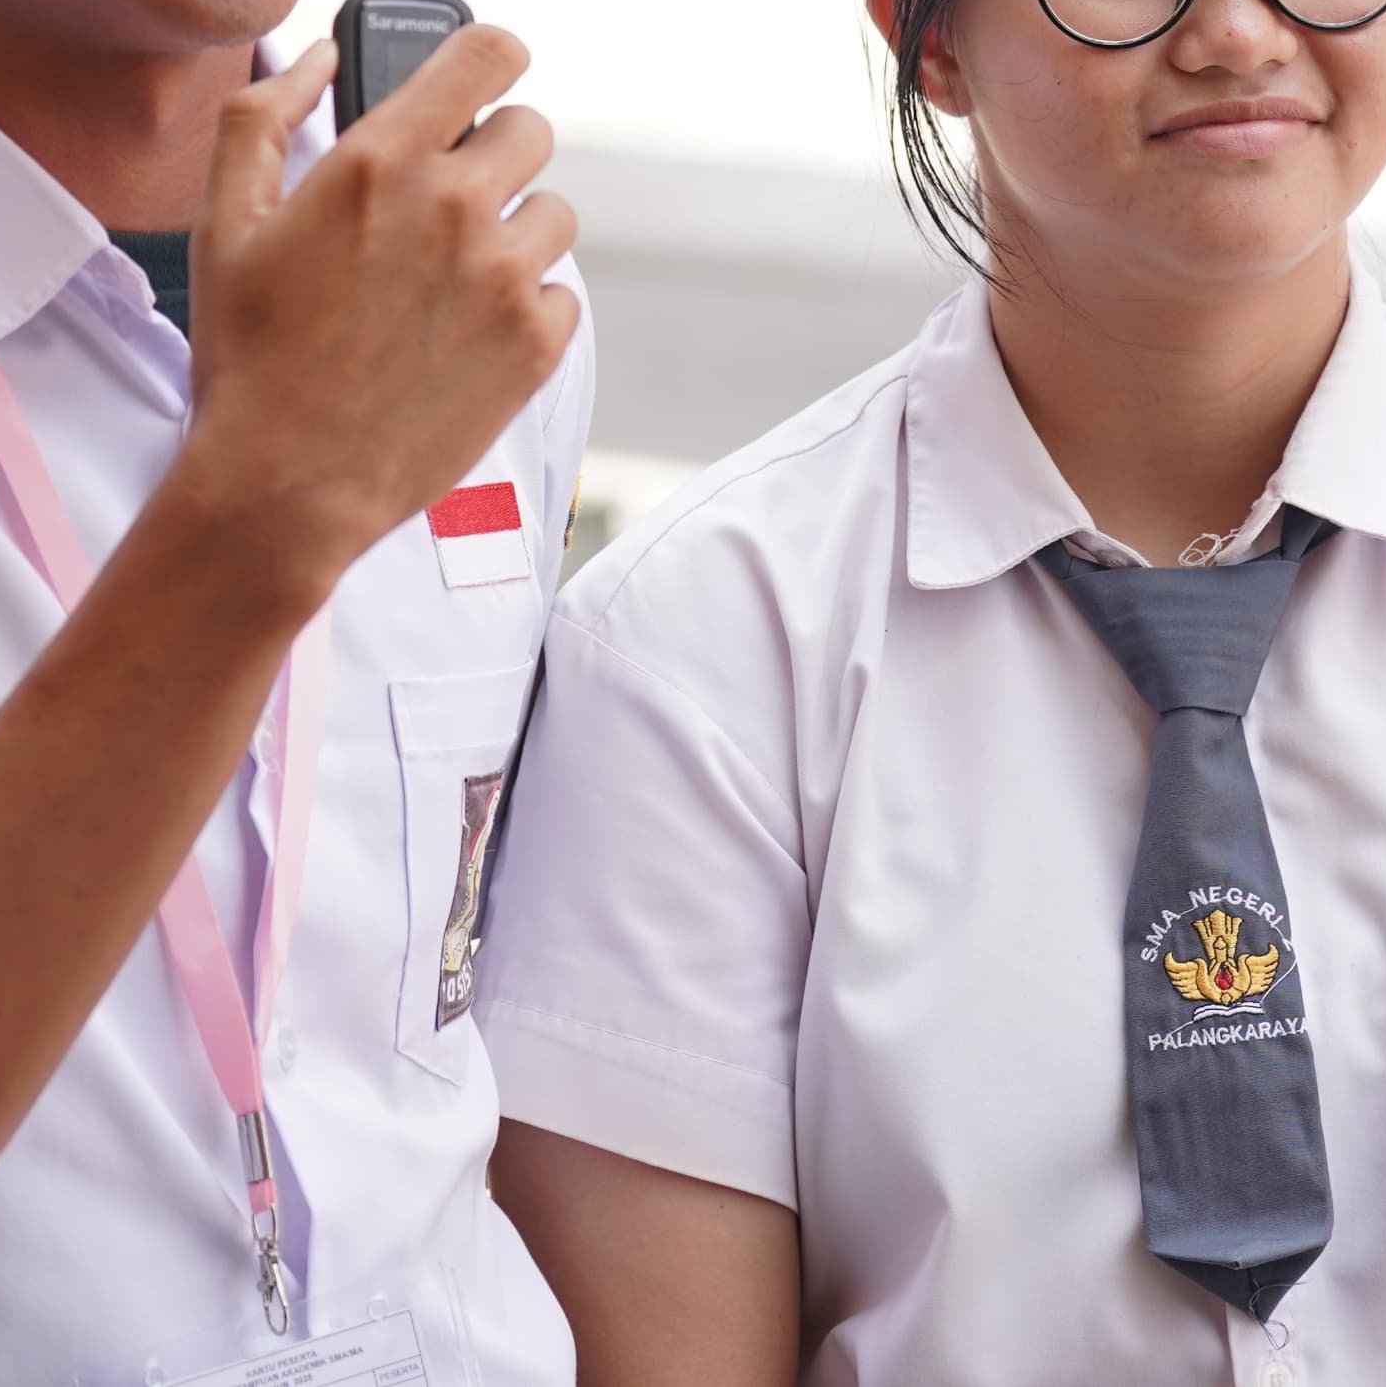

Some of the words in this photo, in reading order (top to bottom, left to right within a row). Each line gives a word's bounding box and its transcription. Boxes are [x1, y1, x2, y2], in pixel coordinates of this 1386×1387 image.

[367, 13, 449, 34] Saramonic
[1140, 909, 1181, 963] SMA
[1188, 886, 1284, 929] NEGERI
[245, 1363, 276, 1379] KARTU
[277, 1350, 318, 1369] PESERTA
[281, 1358, 327, 1378] AKADEMIK
[329, 1346, 364, 1363] SMA/MA
[379, 1363, 419, 1382] PESERTA
